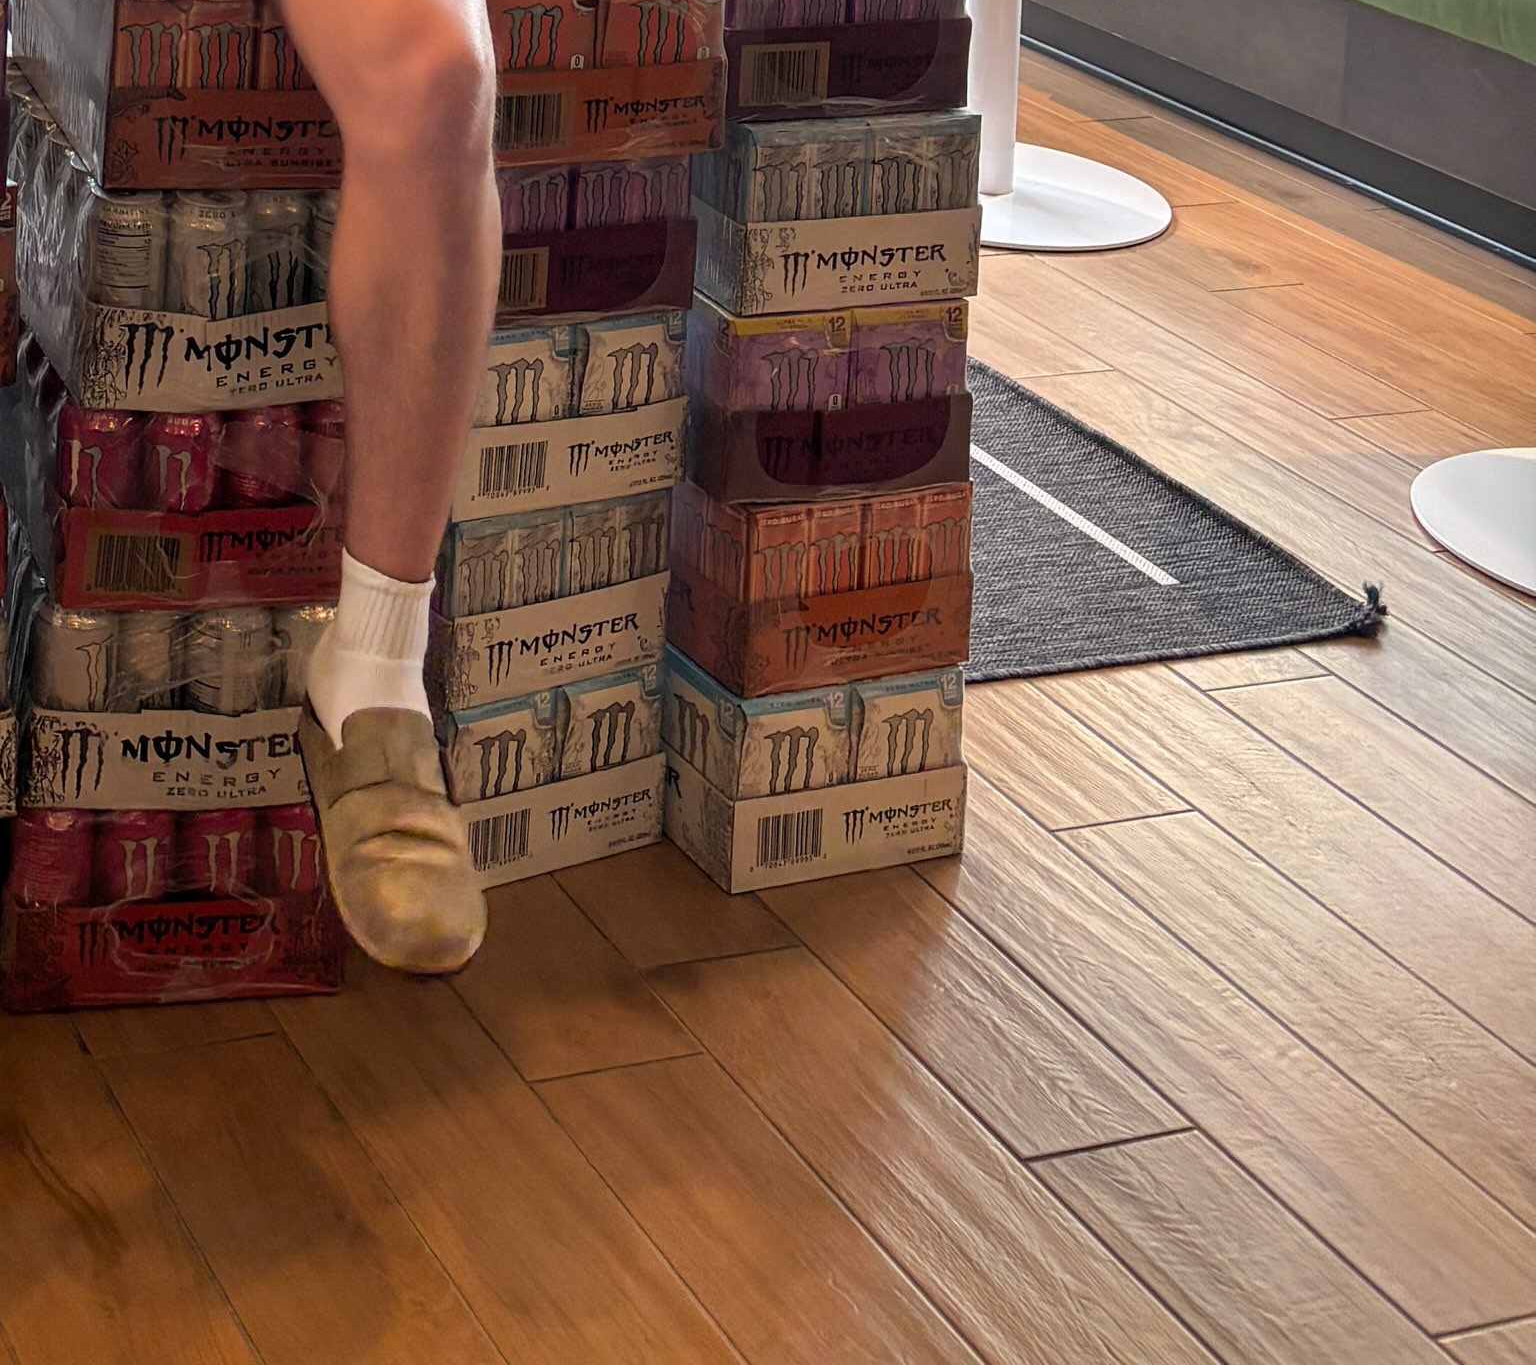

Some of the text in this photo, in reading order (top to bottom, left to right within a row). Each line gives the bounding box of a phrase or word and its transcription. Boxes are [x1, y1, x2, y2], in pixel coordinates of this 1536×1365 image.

[614, 95, 706, 116] MONSTER
[198, 116, 340, 142] MONSTE
[817, 244, 946, 271] MONSTER
[839, 270, 921, 283] ENERGY
[841, 280, 918, 293] ZERO ULTRA
[828, 316, 846, 332] 12
[945, 307, 963, 323] 12
[184, 323, 333, 372] MONST
[216, 356, 338, 388] ENERGY
[275, 374, 324, 389] ULTRA
[594, 431, 674, 457] MONSTER
[519, 613, 639, 655] MONSTER
[817, 608, 942, 642] MONSTER
[540, 642, 616, 667] ENERGY
[940, 673, 957, 690] 12
[827, 691, 844, 708] 12
[121, 730, 300, 768] MONSTE
[153, 768, 281, 786] ENERGY
[166, 785, 267, 798] ZERO ULTRA
[574, 788, 652, 820] MONSTER
[869, 798, 953, 824] MONSTER
[115, 913, 280, 943] MONSTER
